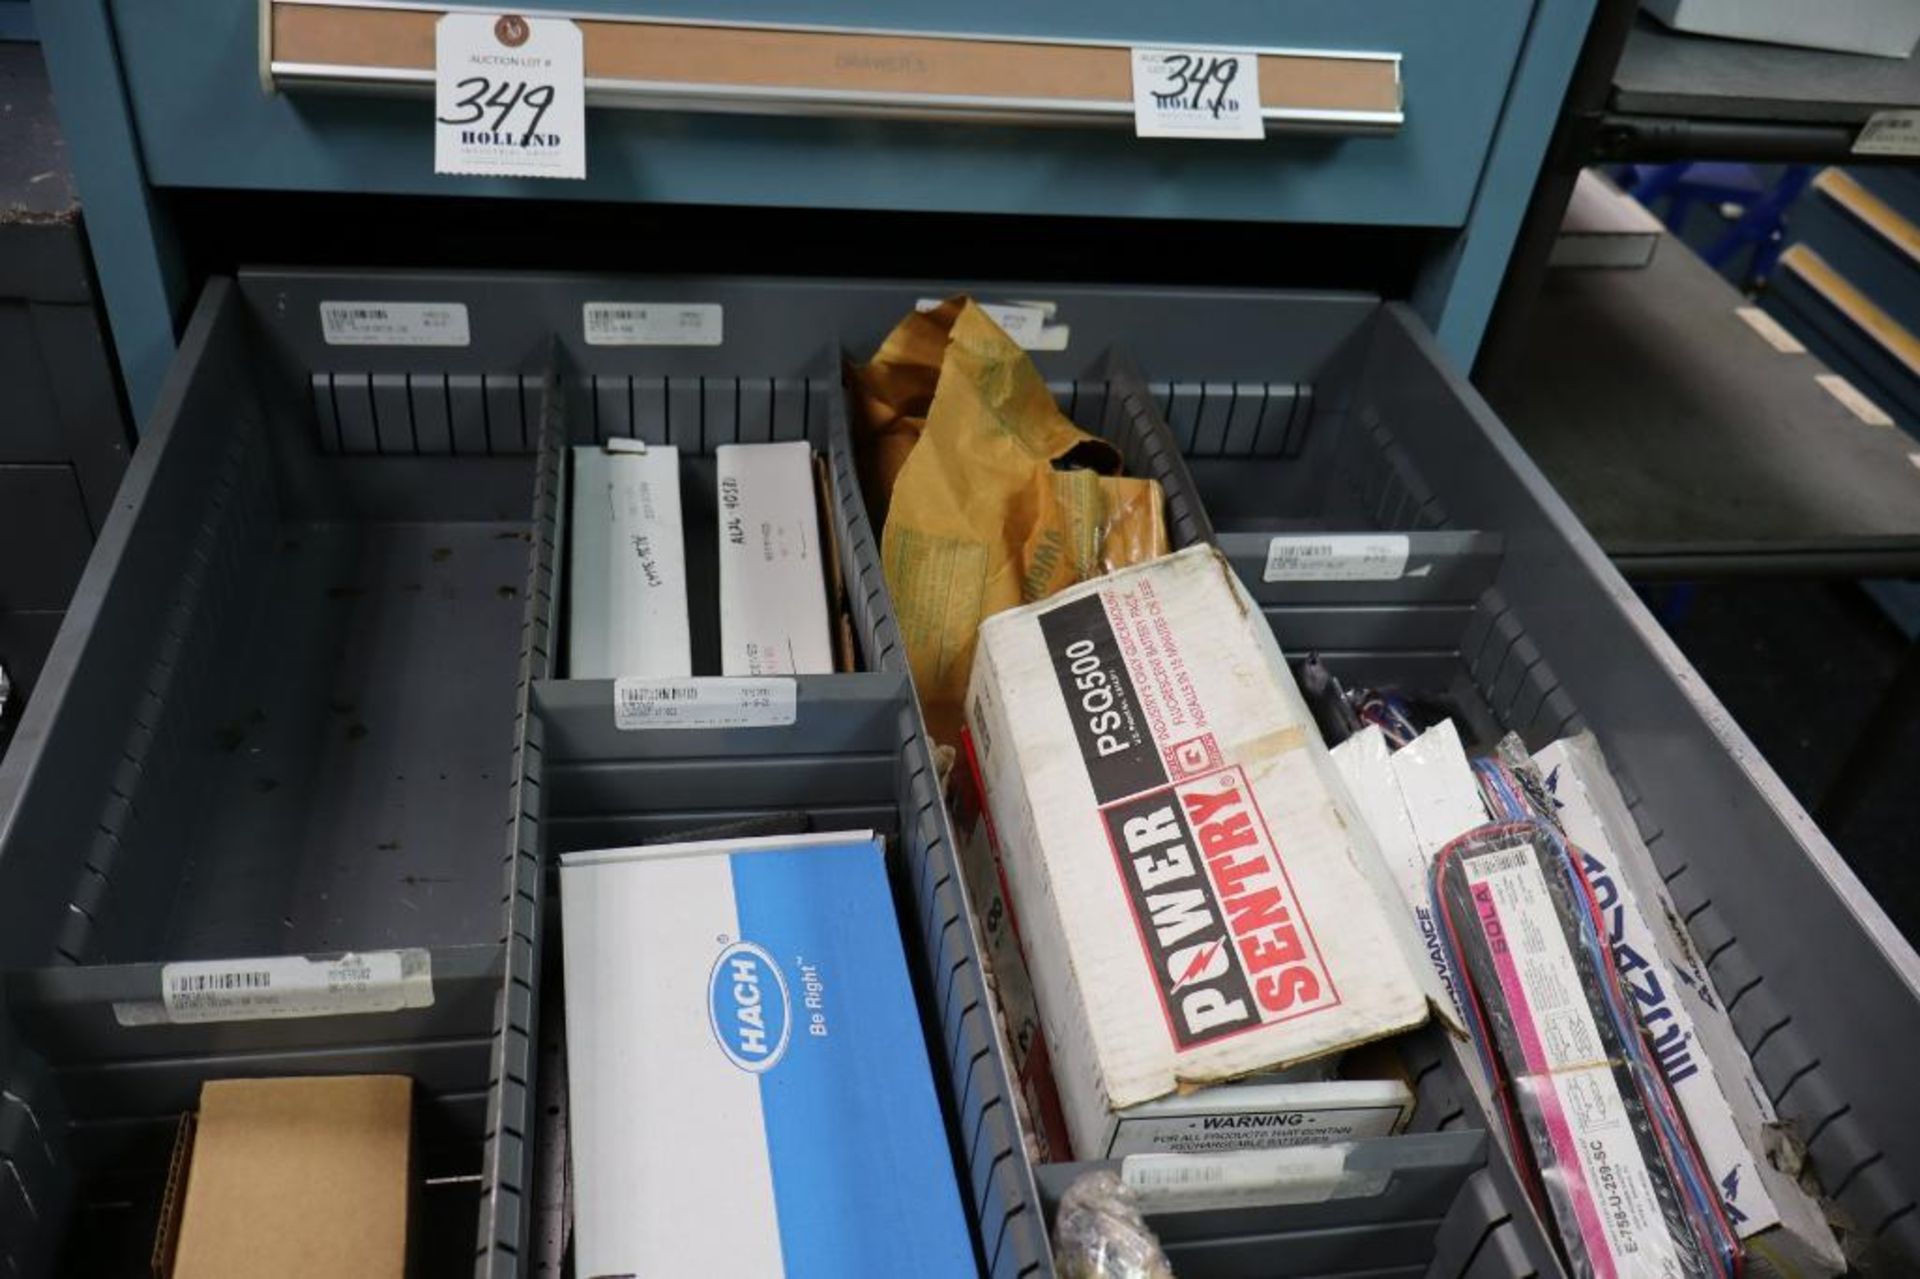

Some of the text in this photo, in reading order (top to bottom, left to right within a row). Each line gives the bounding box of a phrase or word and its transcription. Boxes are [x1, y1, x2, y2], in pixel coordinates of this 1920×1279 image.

[470, 56, 519, 66] AUCTION
[520, 57, 541, 67] LOT
[1151, 55, 1239, 119] 349
[437, 77, 555, 147] 349
[462, 131, 561, 147] HOLLAND
[1136, 618, 1157, 657] BATTERY
[1156, 616, 1178, 658] MINUTES
[1065, 639, 1130, 756] PSQ500
[1130, 658, 1148, 683] ONLY
[1151, 657, 1184, 724] FLUORESCENT
[1183, 683, 1208, 728] INSTALLS
[1124, 806, 1249, 1034] POWER
[1183, 789, 1320, 1011] SENTRY
[1475, 889, 1507, 953] SOLA
[731, 959, 768, 1053] HACH
[801, 965, 828, 1036] Be Right
[1153, 1134, 1178, 1143] FOR
[1184, 1133, 1200, 1141] ALL
[1204, 1130, 1268, 1140] PRODUCTS
[1301, 1126, 1352, 1135] CONTAIN
[1203, 1114, 1303, 1129] WARNING
[1590, 1141, 1638, 1254] E-758-U-259-SC
